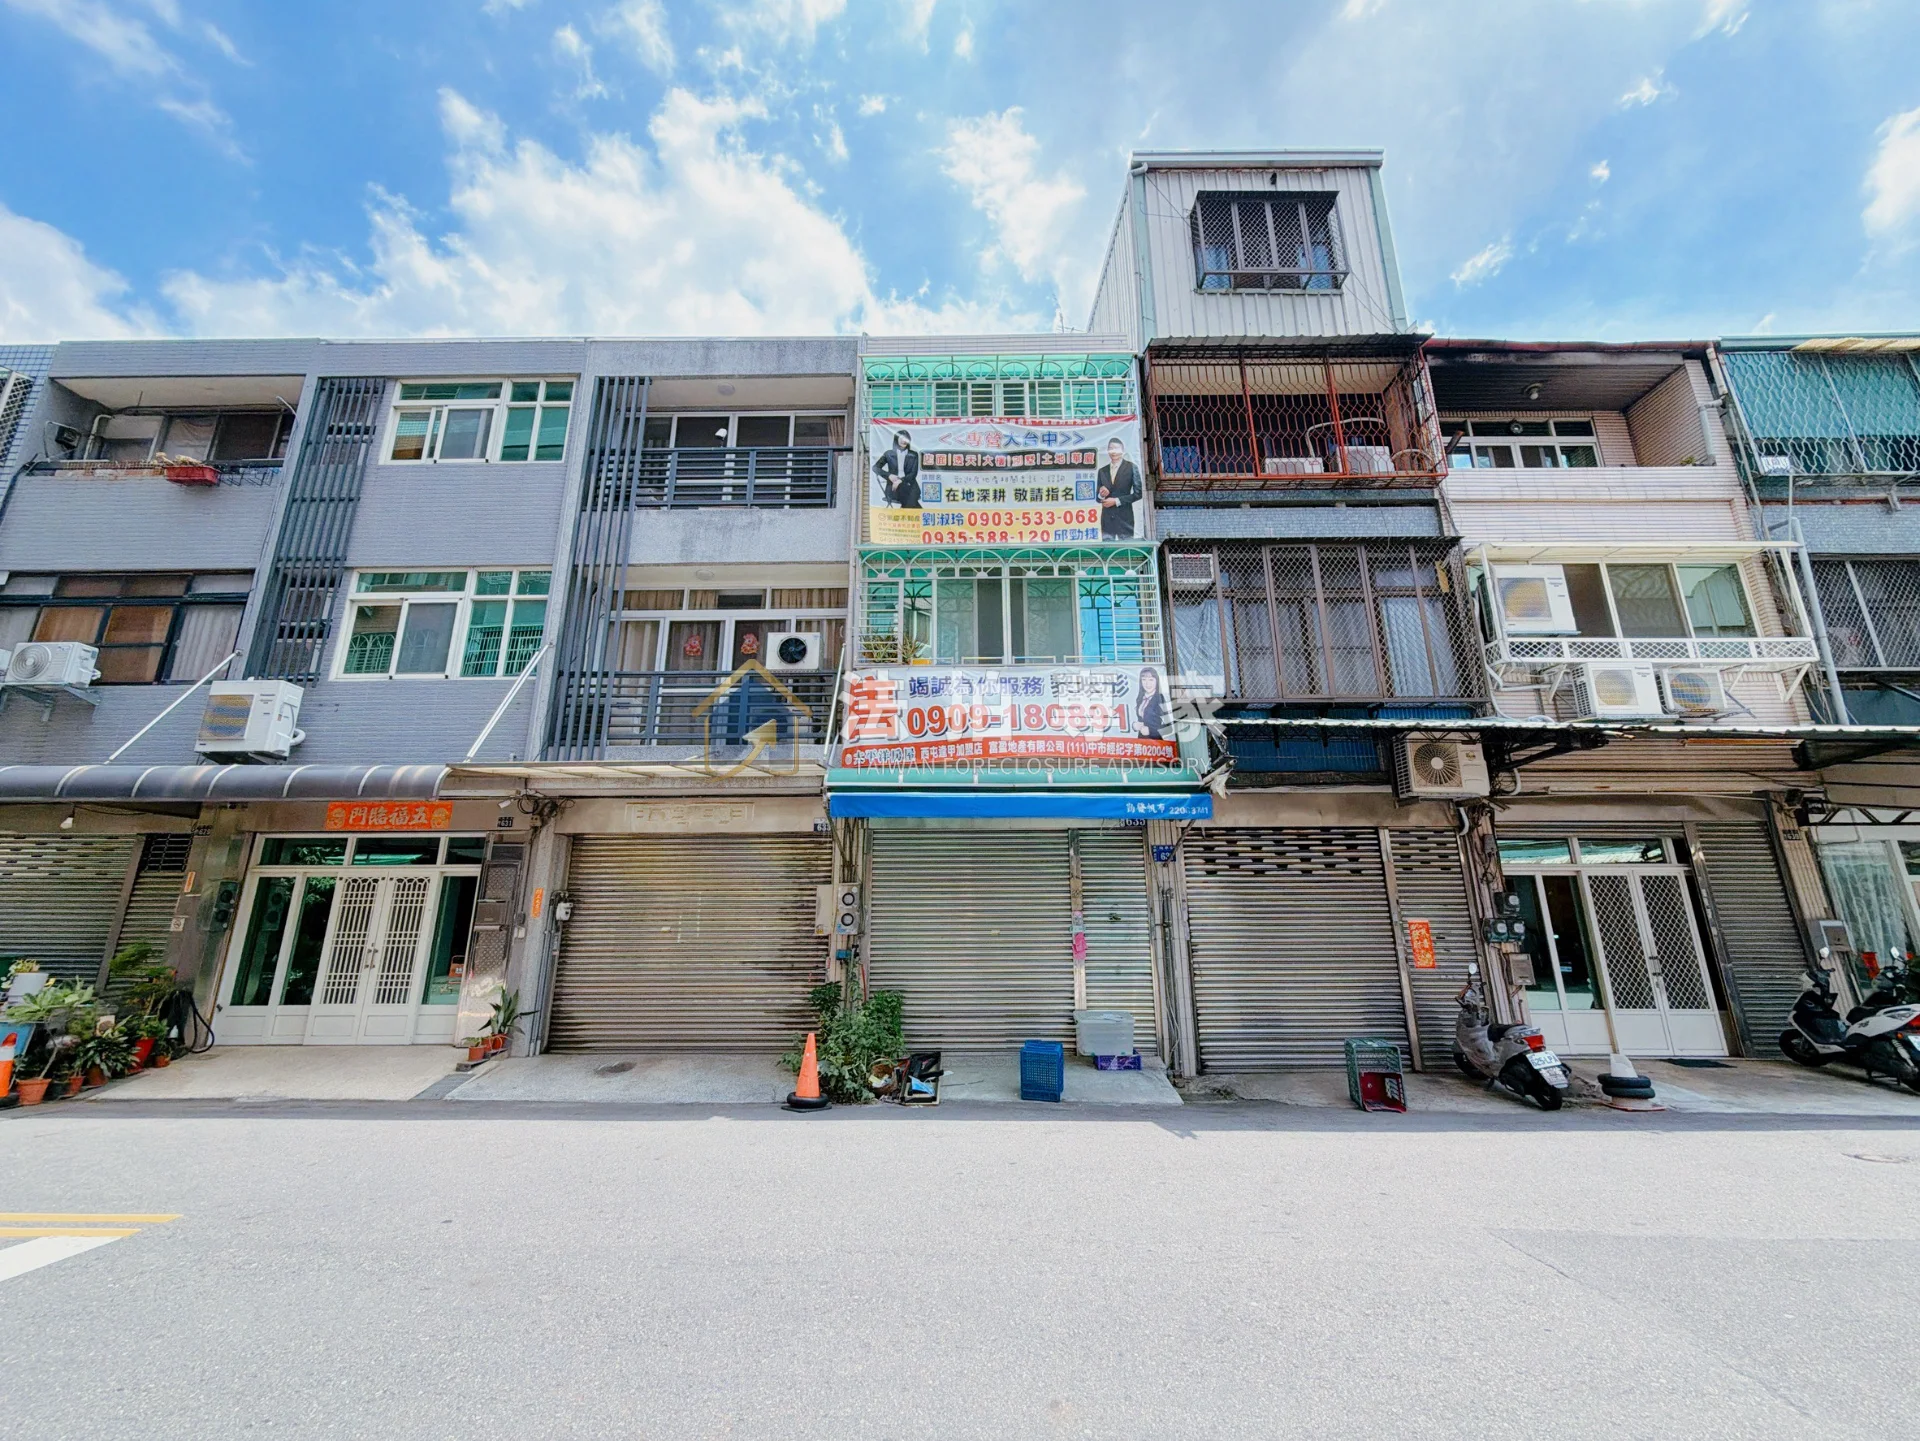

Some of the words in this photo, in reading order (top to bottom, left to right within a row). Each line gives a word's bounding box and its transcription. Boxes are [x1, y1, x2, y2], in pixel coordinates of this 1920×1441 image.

[944, 488, 1006, 503] 在地深耕
[1013, 487, 1074, 502] 敬請指名
[921, 512, 964, 527] 劉淑玲
[967, 508, 1098, 526] 0903-533-068
[922, 529, 1050, 544] 0935-588-120
[1054, 528, 1099, 542] 邱勁捷
[908, 675, 1044, 697] 竭誠為你服務
[906, 702, 1130, 738] 0909-180891
